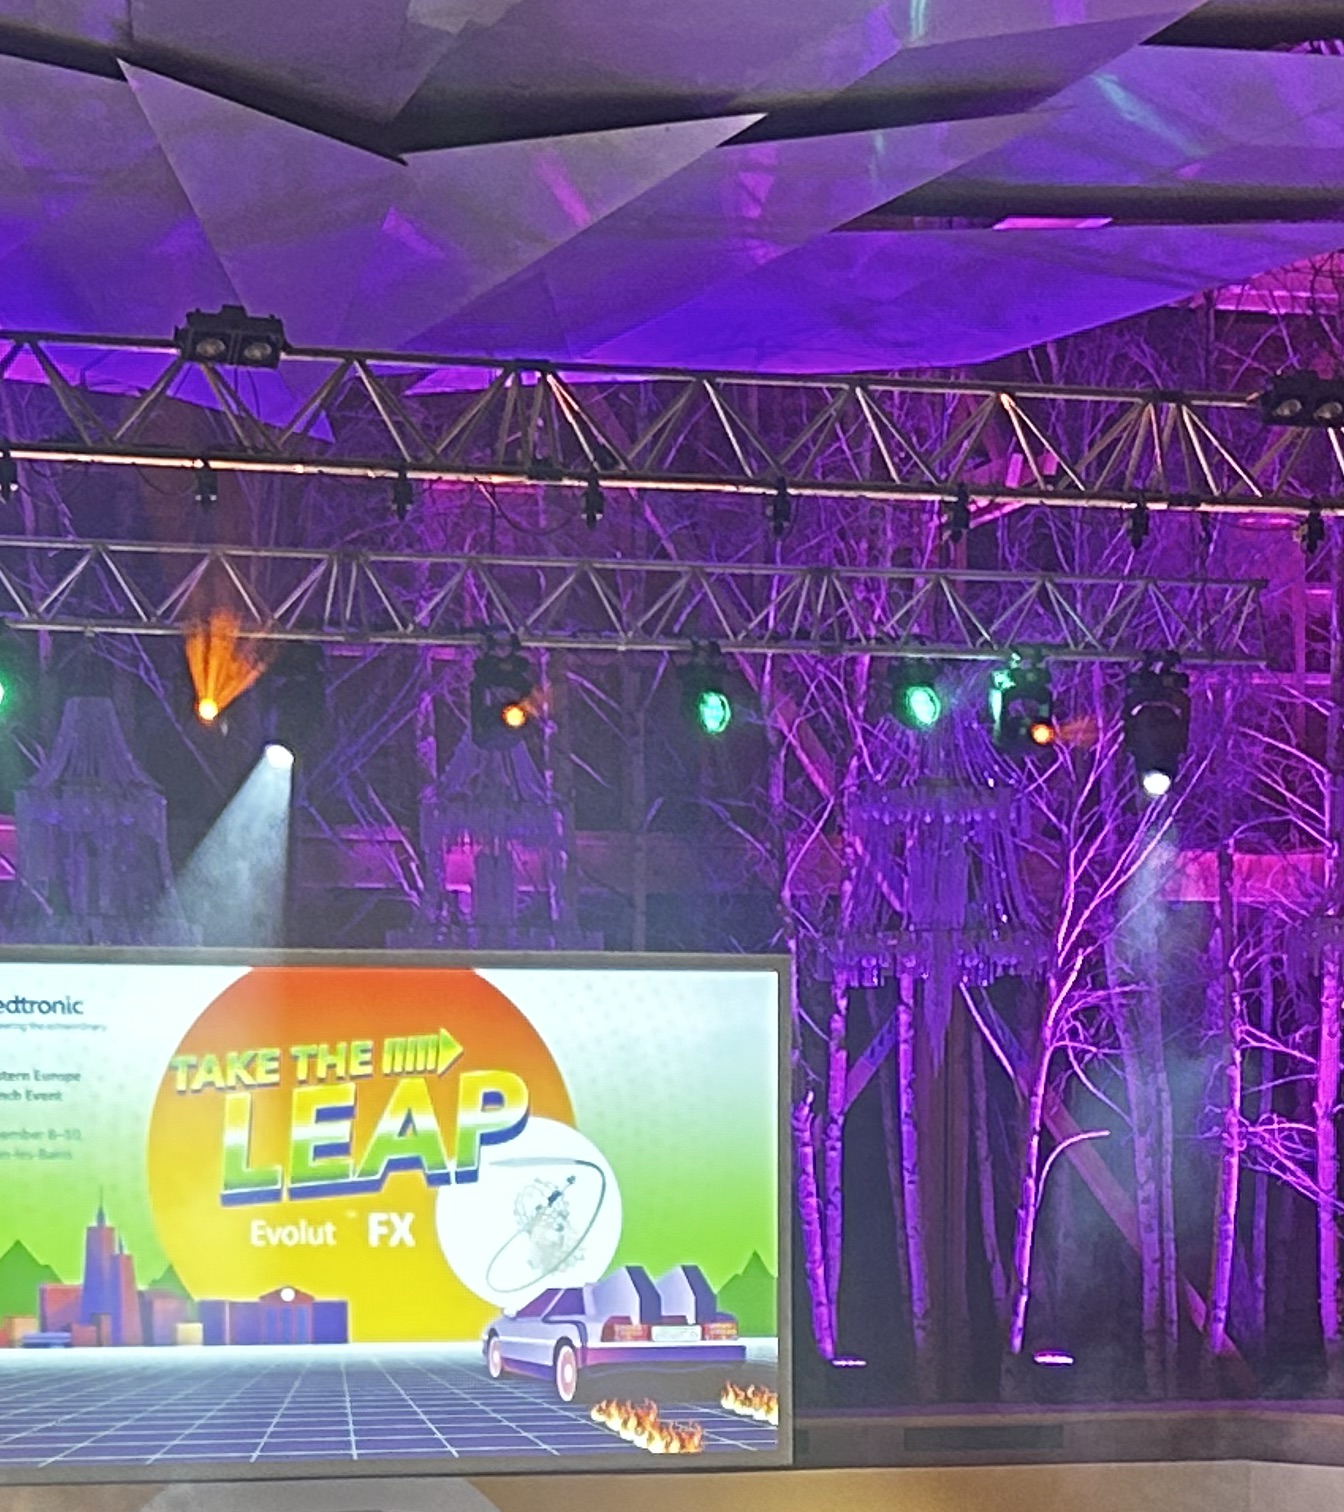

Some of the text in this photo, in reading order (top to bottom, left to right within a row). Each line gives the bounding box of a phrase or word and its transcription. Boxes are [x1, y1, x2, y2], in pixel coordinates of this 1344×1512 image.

[34, 1069, 81, 1083] Europe
[170, 1040, 374, 1093] TAKE THE
[25, 1089, 63, 1101] Event
[219, 1070, 530, 1207] LEAP
[250, 1212, 416, 1248] Evolut FX
